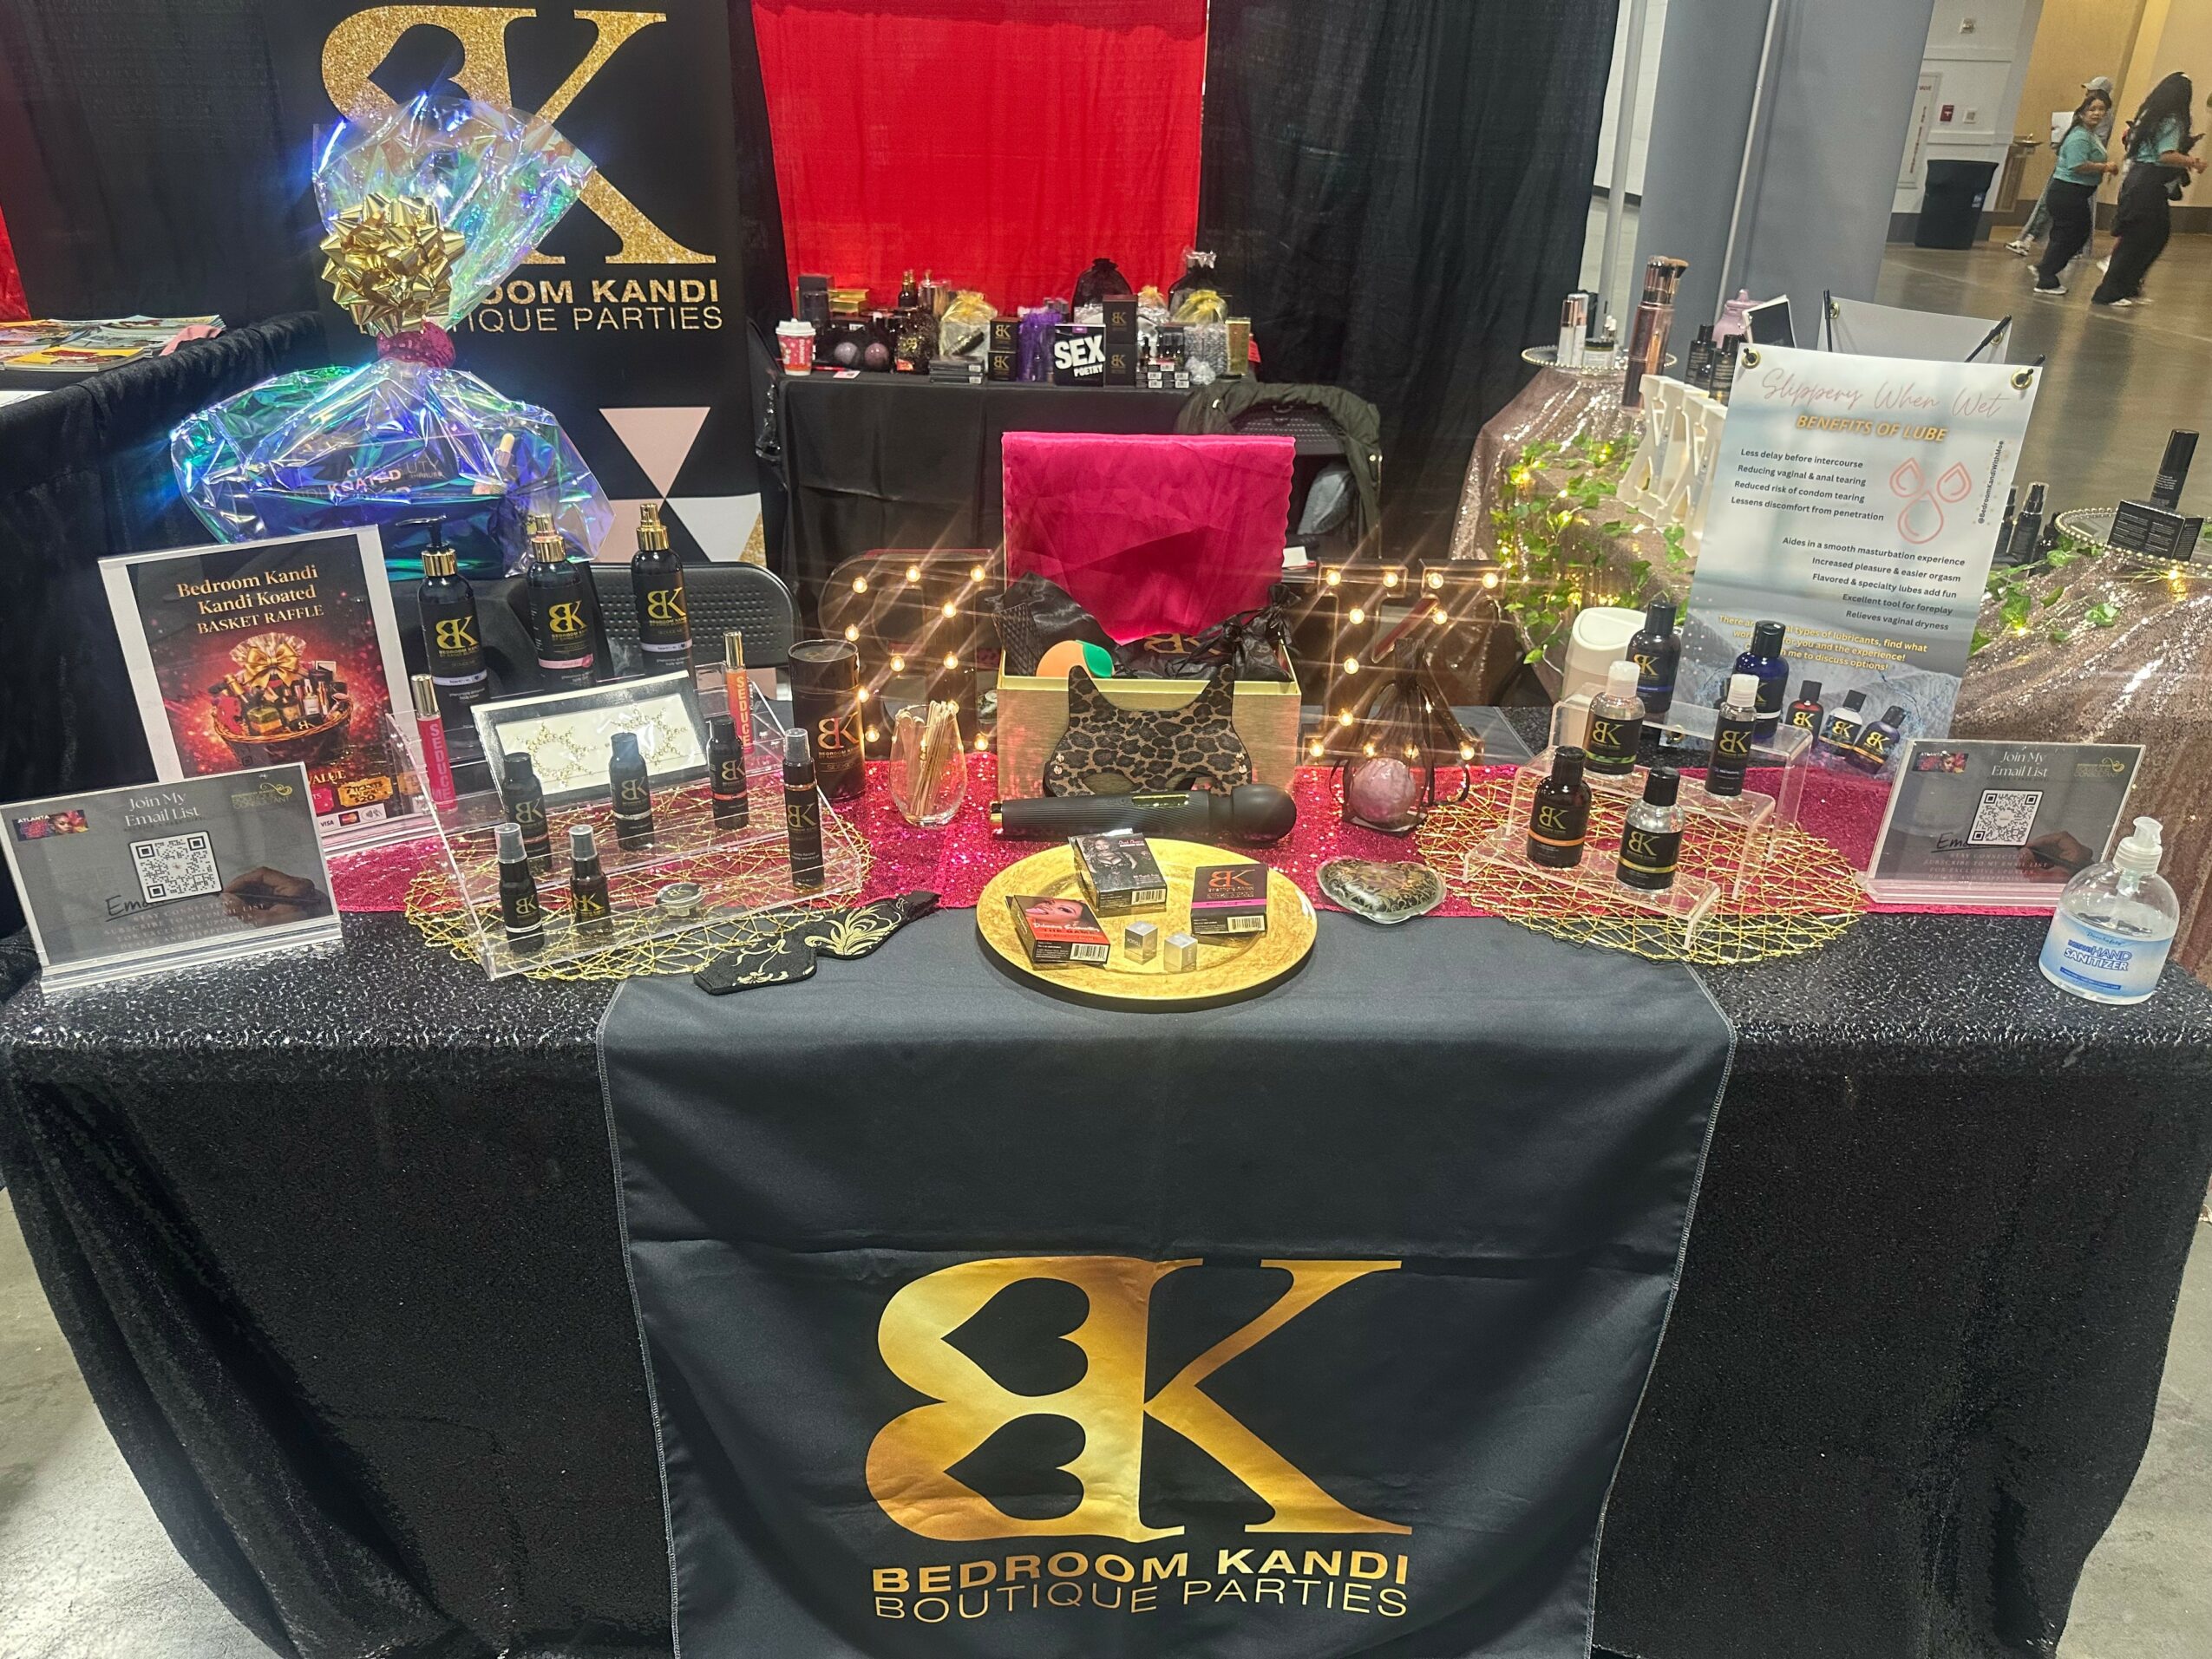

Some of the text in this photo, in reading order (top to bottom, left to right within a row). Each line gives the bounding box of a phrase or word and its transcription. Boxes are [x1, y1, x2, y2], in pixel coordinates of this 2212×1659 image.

[592, 279, 718, 304] KANDI
[573, 307, 723, 330] PARTIES
[1054, 335, 1106, 369] SEX
[1073, 364, 1103, 377] POETRY
[1762, 368, 2010, 418] Slippery When Wet
[1796, 415, 1948, 442] BENEFITS OF LUBE
[1741, 448, 1863, 468] Less delay before intercourse
[1738, 465, 1776, 477] Reducing
[1777, 469, 1807, 480] vaginal
[1816, 473, 1835, 482] anal
[1836, 475, 1867, 487] tearing
[1734, 480, 1770, 492] Reduced
[1798, 488, 1833, 499] condom
[1835, 493, 1865, 504] tearing
[1731, 496, 1884, 521] Lessens discomfort from penetration
[1782, 537, 1806, 547] Aides
[1807, 539, 1816, 548] in
[1823, 543, 1855, 552] smooth
[1857, 547, 1915, 561] masturbation
[1917, 555, 1966, 566] experience
[177, 564, 318, 598] Bedroom Kandi
[1812, 557, 1853, 569] Increased
[1855, 563, 1892, 575] pleasure
[1901, 568, 1927, 578] easier
[1929, 573, 1961, 583] orgasm
[1812, 573, 1849, 585] Flavored
[1858, 579, 1897, 592] specialty
[1898, 582, 1922, 594] lubes
[1923, 587, 1940, 598] add
[1942, 590, 1957, 598] fun
[198, 585, 317, 615] Kandi Koated
[647, 587, 686, 619] BK
[1842, 593, 1953, 616] Excellent tool for foreplay
[197, 604, 324, 635] BASKET RAFFLE
[548, 600, 588, 633] BK
[1845, 610, 1949, 630] Relieves vaginal dryness
[435, 616, 479, 650] BK
[1718, 615, 1744, 625] There
[1795, 627, 1821, 638] types
[1833, 631, 1882, 647] lubricants,
[1883, 638, 1903, 649] find
[1904, 642, 1927, 653] what
[1797, 640, 1814, 650] you
[1815, 641, 1833, 651] and
[1835, 643, 1850, 653] the
[1851, 646, 1906, 663] experience!
[1803, 651, 1813, 660] to
[1815, 652, 1849, 666] discuss
[1850, 658, 1888, 672] options!
[736, 676, 751, 748] SEDUCE
[1793, 711, 1815, 728] BK
[818, 711, 861, 749] BK
[1592, 721, 1624, 746] BK
[1719, 730, 1751, 754] BK
[1832, 721, 1854, 739] BK
[1866, 731, 1890, 752] BK
[721, 757, 746, 781] BK
[2000, 751, 2047, 765] Join My
[1991, 765, 2048, 778] Email List
[621, 776, 649, 800] BK
[129, 792, 187, 812] Join My
[515, 798, 544, 823] BK
[17, 814, 50, 824] ATLANTA
[125, 808, 169, 827] Email
[173, 806, 200, 821] List
[787, 802, 817, 828] BK
[1539, 806, 1569, 830] BK
[1628, 831, 1660, 857] BK
[1207, 869, 1256, 889] BK
[516, 894, 538, 914] BK
[2065, 948, 2129, 971] SANITIZER
[2091, 945, 2132, 962] HAND
[865, 1255, 1412, 1542] BK
[873, 1548, 1408, 1593] BEDROOM KANDI
[876, 1578, 1408, 1623] BOUTIQUE PARTIES
